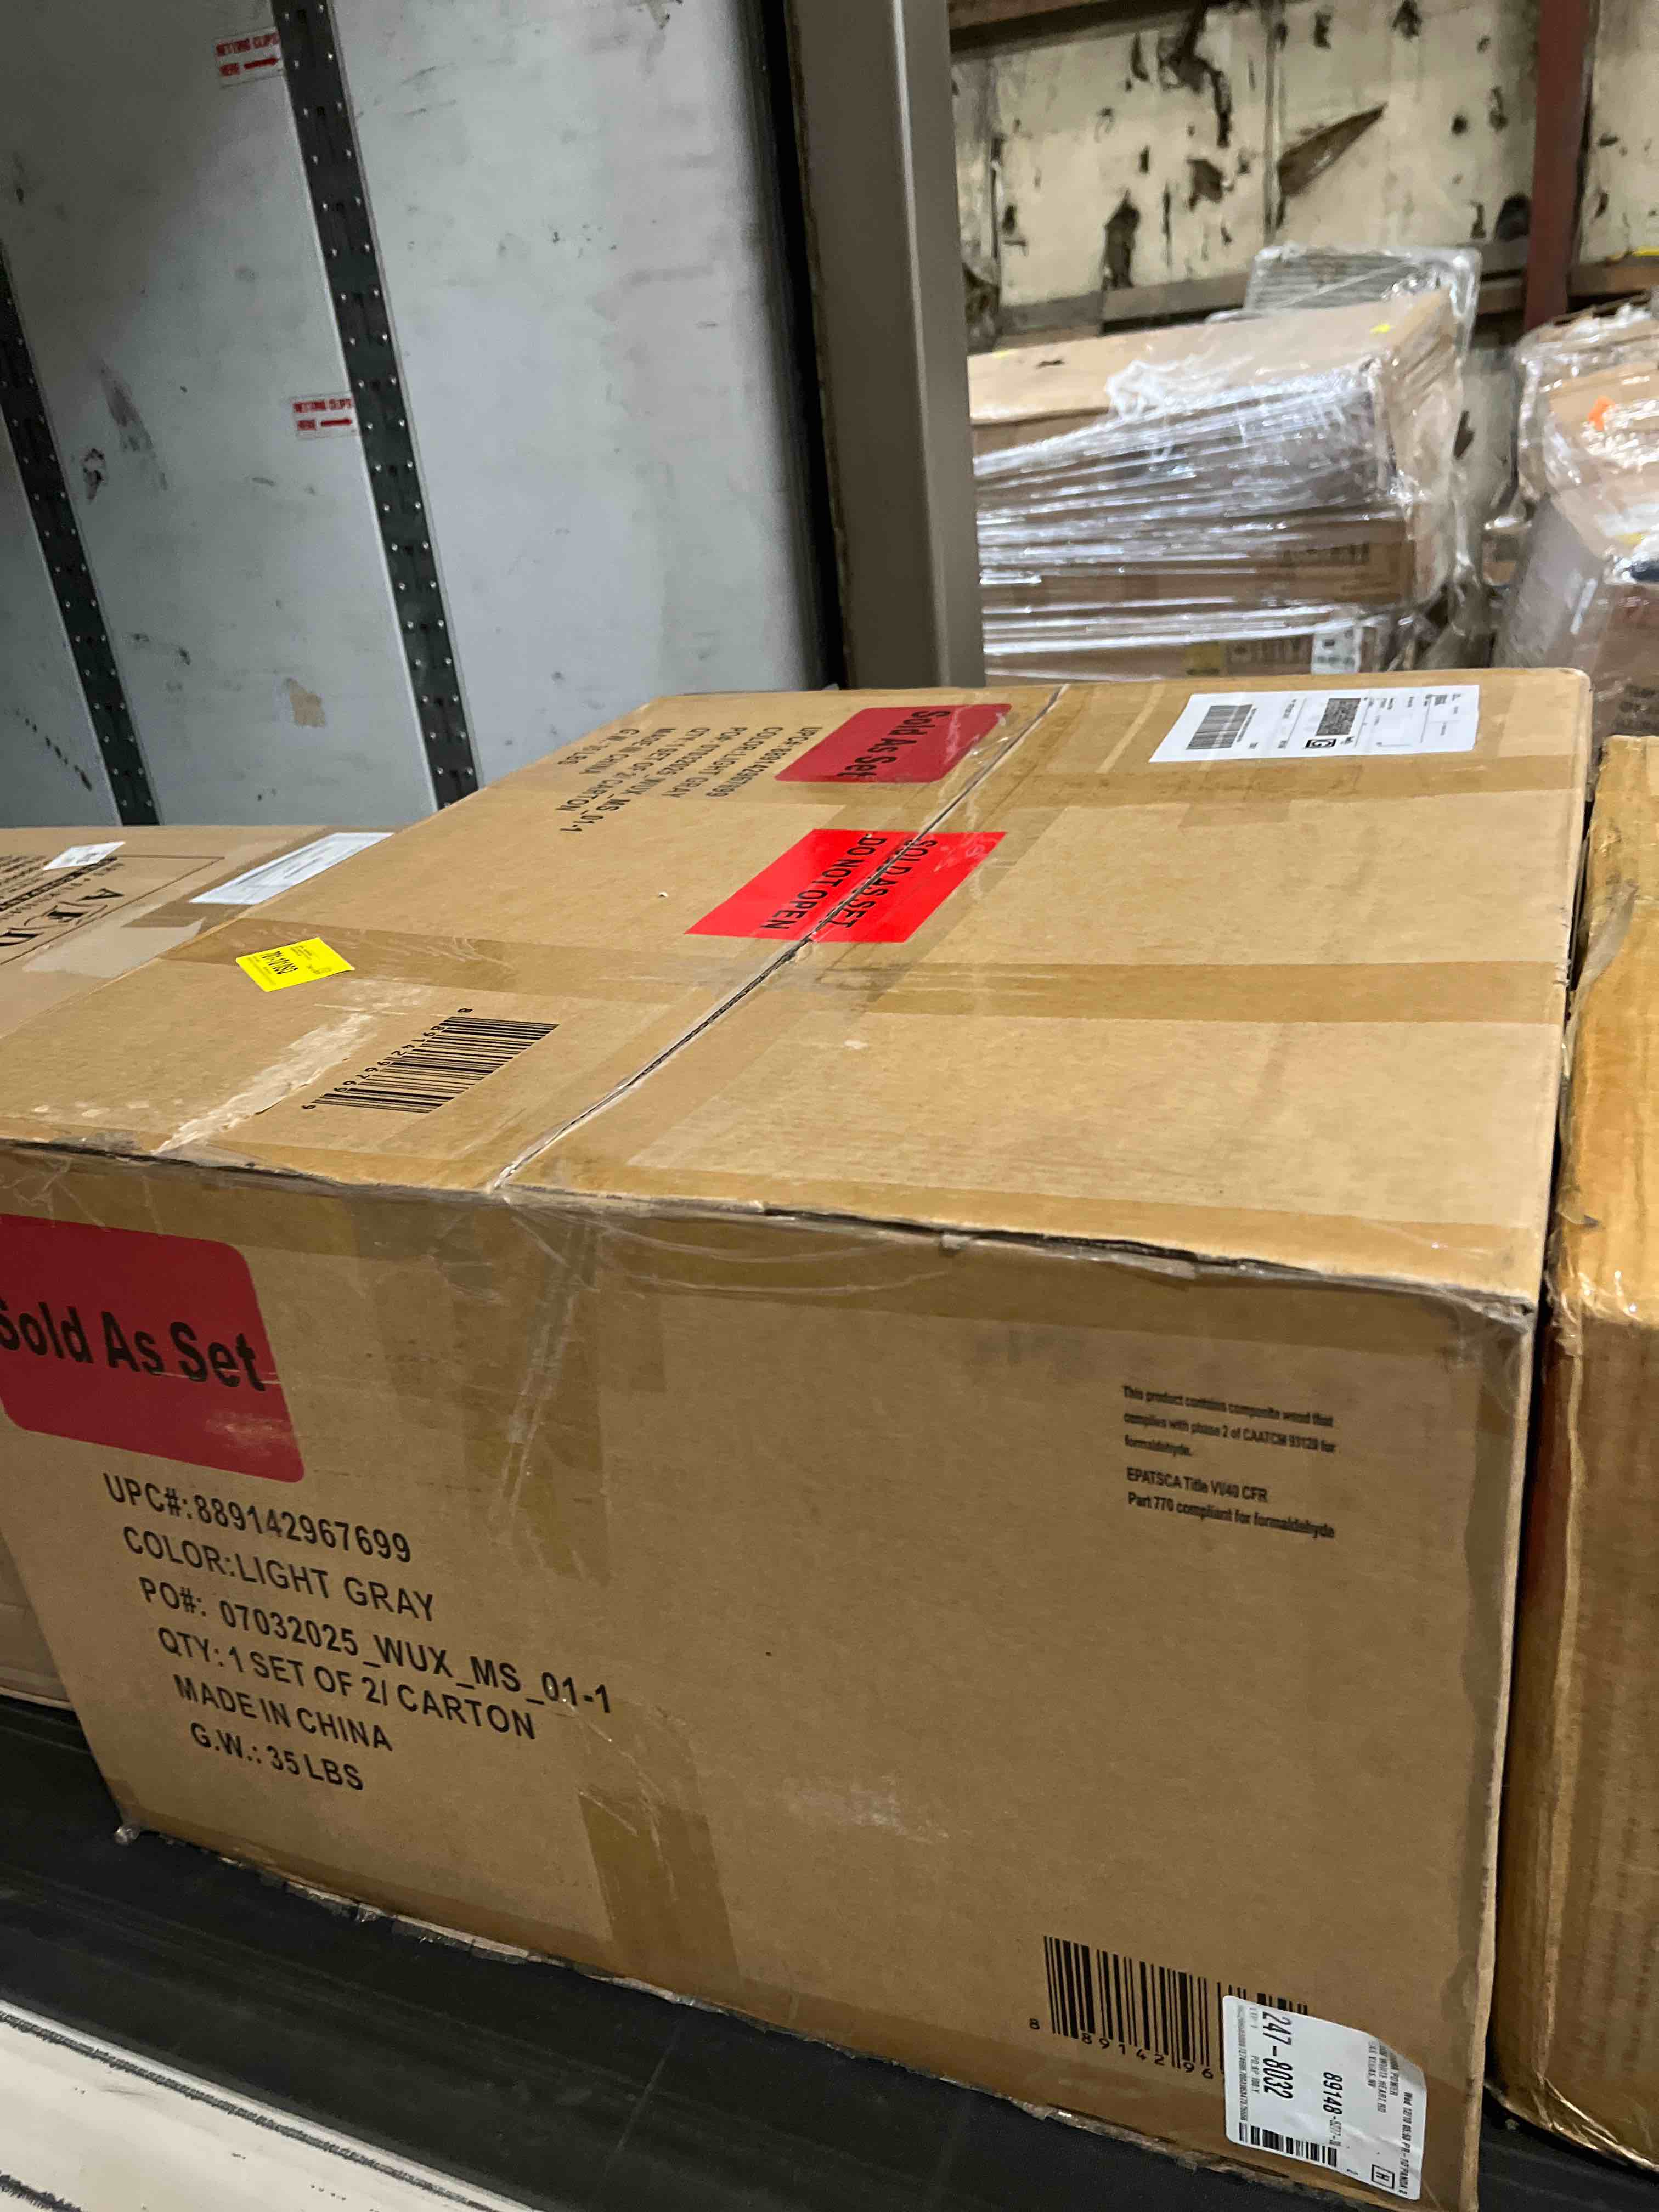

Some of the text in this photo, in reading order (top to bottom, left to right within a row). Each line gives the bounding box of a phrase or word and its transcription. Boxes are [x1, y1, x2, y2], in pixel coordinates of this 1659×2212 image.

[837, 710, 951, 778] Sold As Set
[555, 779, 623, 811] CARTON
[662, 777, 709, 798] GRAY
[760, 836, 888, 929] DO NOT OPEN
[101, 1311, 166, 1376] As
[170, 1321, 266, 1392] Set
[1223, 1425, 1228, 1437] 2
[1128, 1491, 1152, 1509] Part
[1154, 1496, 1175, 1512] 770
[1242, 1485, 1268, 1503] CFR
[122, 1526, 433, 1622] COLOR:LIGHT GRAY
[138, 1576, 207, 1617] PO#:
[173, 1674, 393, 1752] MADE IN CHINA
[250, 1651, 304, 1686] SET
[314, 1666, 352, 1696] OF
[397, 1684, 536, 1739] CARTON
[304, 1754, 364, 1790] LBS
[1029, 2018, 1224, 2080] 8 89142 96
